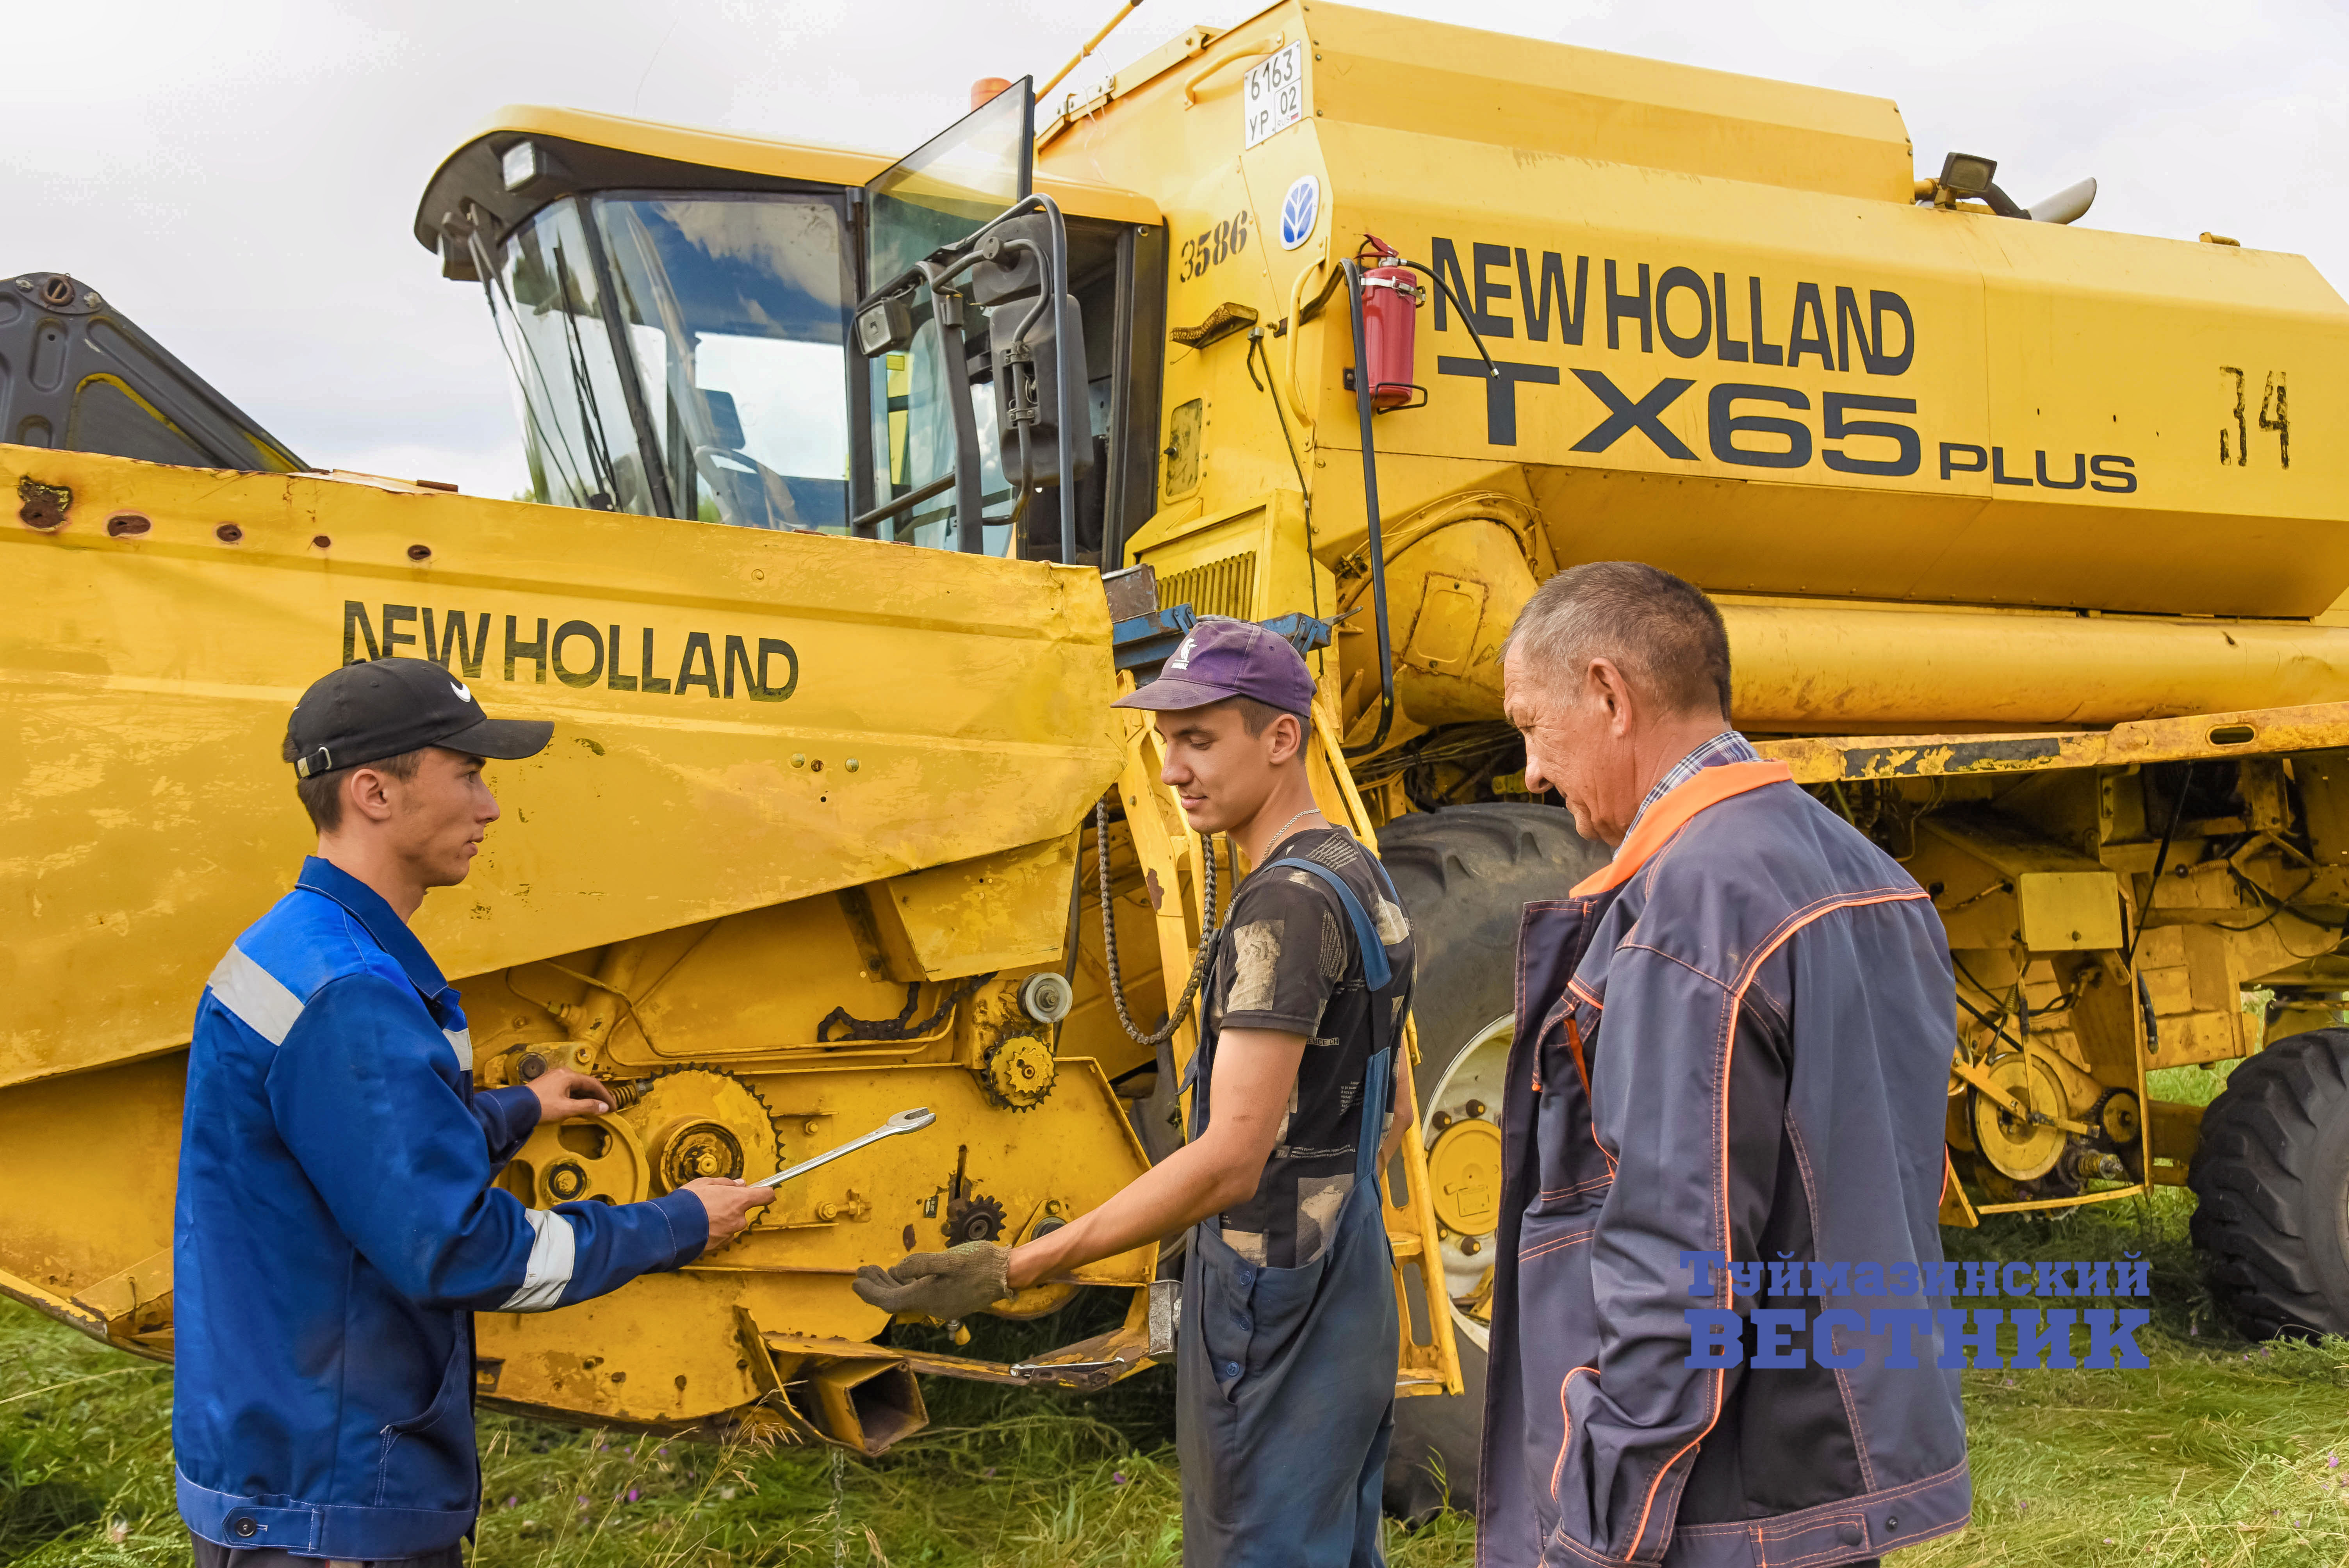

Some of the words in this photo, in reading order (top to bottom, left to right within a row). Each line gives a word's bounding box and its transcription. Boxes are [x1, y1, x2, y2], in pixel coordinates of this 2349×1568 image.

[1251, 49, 1292, 100] 6163
[1280, 86, 1296, 114] 02
[1180, 210, 1247, 283] 3586
[1432, 237, 1588, 345] NEW
[1606, 260, 1914, 375] HOLLAND
[1438, 356, 1920, 476] TX65
[1940, 443, 2137, 493] PLUS
[2220, 366, 2289, 469] 34
[343, 600, 491, 678] NEW
[505, 615, 798, 701] HOLLAND
